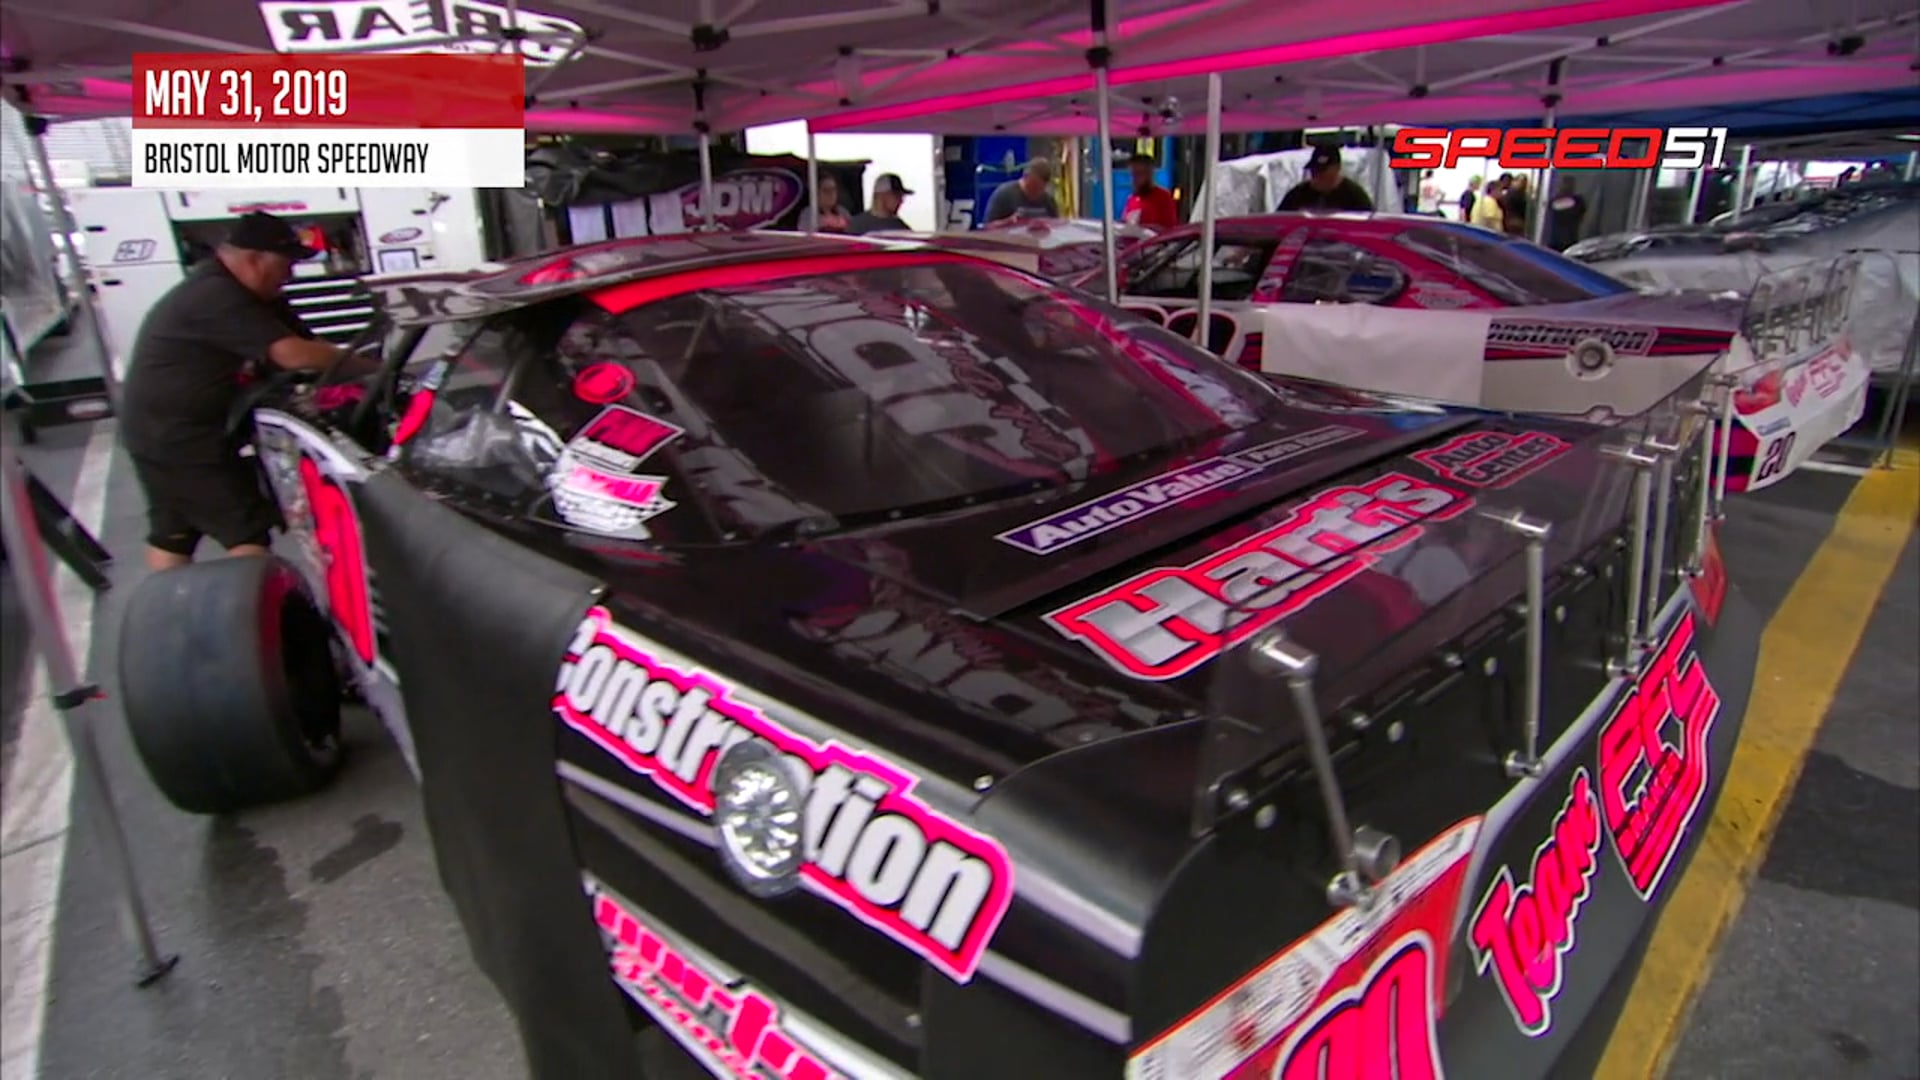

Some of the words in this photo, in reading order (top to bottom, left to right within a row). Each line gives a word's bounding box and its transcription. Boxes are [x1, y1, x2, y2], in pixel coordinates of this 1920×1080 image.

[1434, 436, 1513, 467] Auto
[1078, 476, 1458, 668] Hart's
[1471, 770, 1598, 1029] Team
